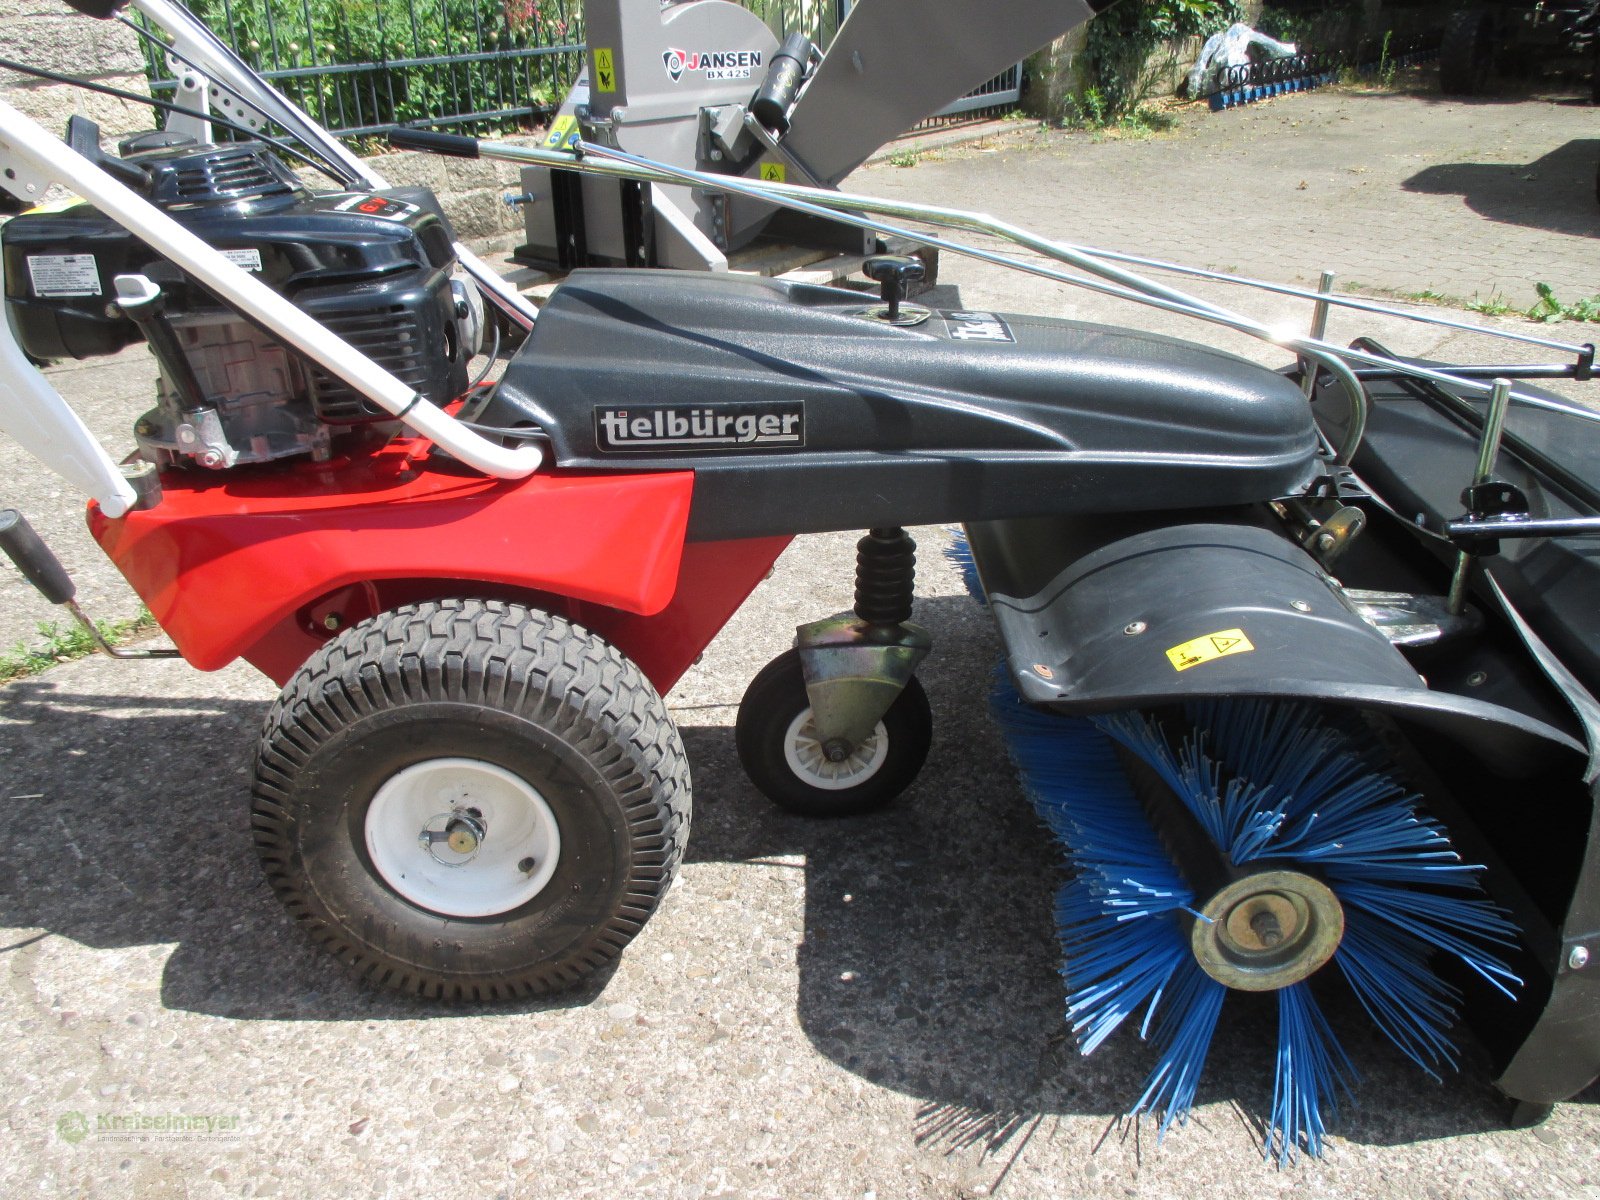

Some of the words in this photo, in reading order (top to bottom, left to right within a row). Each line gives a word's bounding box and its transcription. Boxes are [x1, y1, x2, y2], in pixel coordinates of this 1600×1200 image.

[687, 51, 761, 70] JANSEN
[707, 71, 724, 79] BX
[726, 69, 750, 78] 42S
[600, 409, 799, 445] tielbürger
